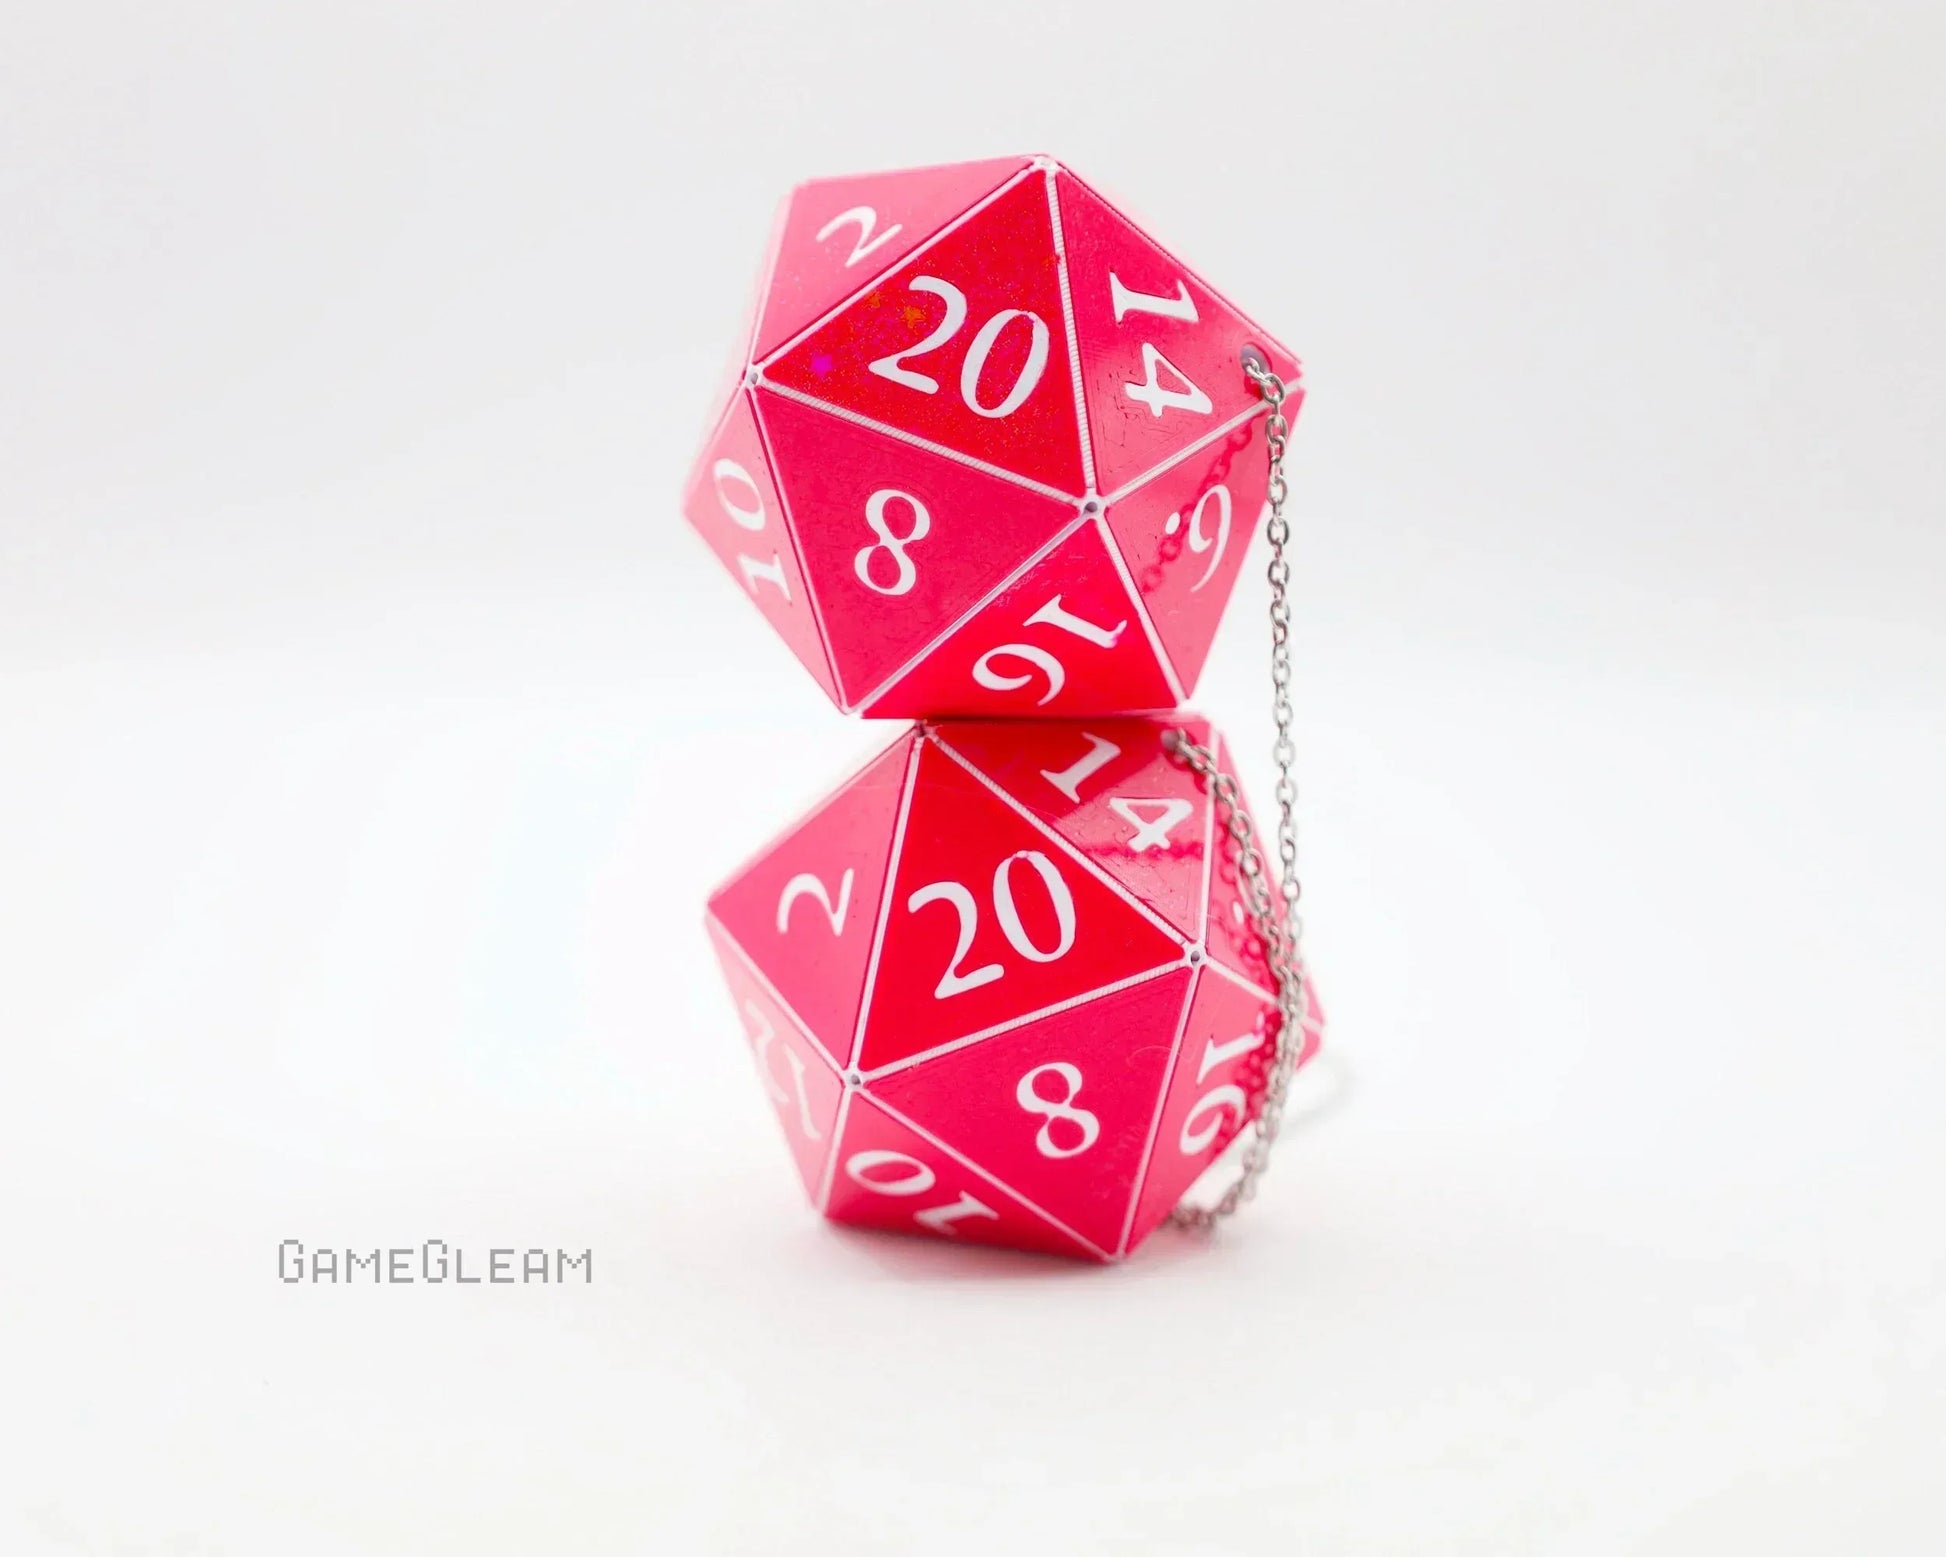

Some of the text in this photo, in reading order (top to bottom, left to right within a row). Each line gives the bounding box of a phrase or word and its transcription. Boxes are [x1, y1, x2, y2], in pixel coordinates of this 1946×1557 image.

[816, 205, 902, 267] 2
[869, 275, 1049, 418] 20
[1110, 271, 1212, 417] 14
[713, 458, 792, 599] 10
[854, 490, 930, 595] 8
[972, 594, 1127, 705] 16
[1041, 732, 1193, 851] 14
[777, 868, 853, 936] 2
[908, 850, 1076, 998] 20
[1017, 1062, 1099, 1159] 8
[1179, 1011, 1264, 1155] 16
[845, 1149, 999, 1234] 10
